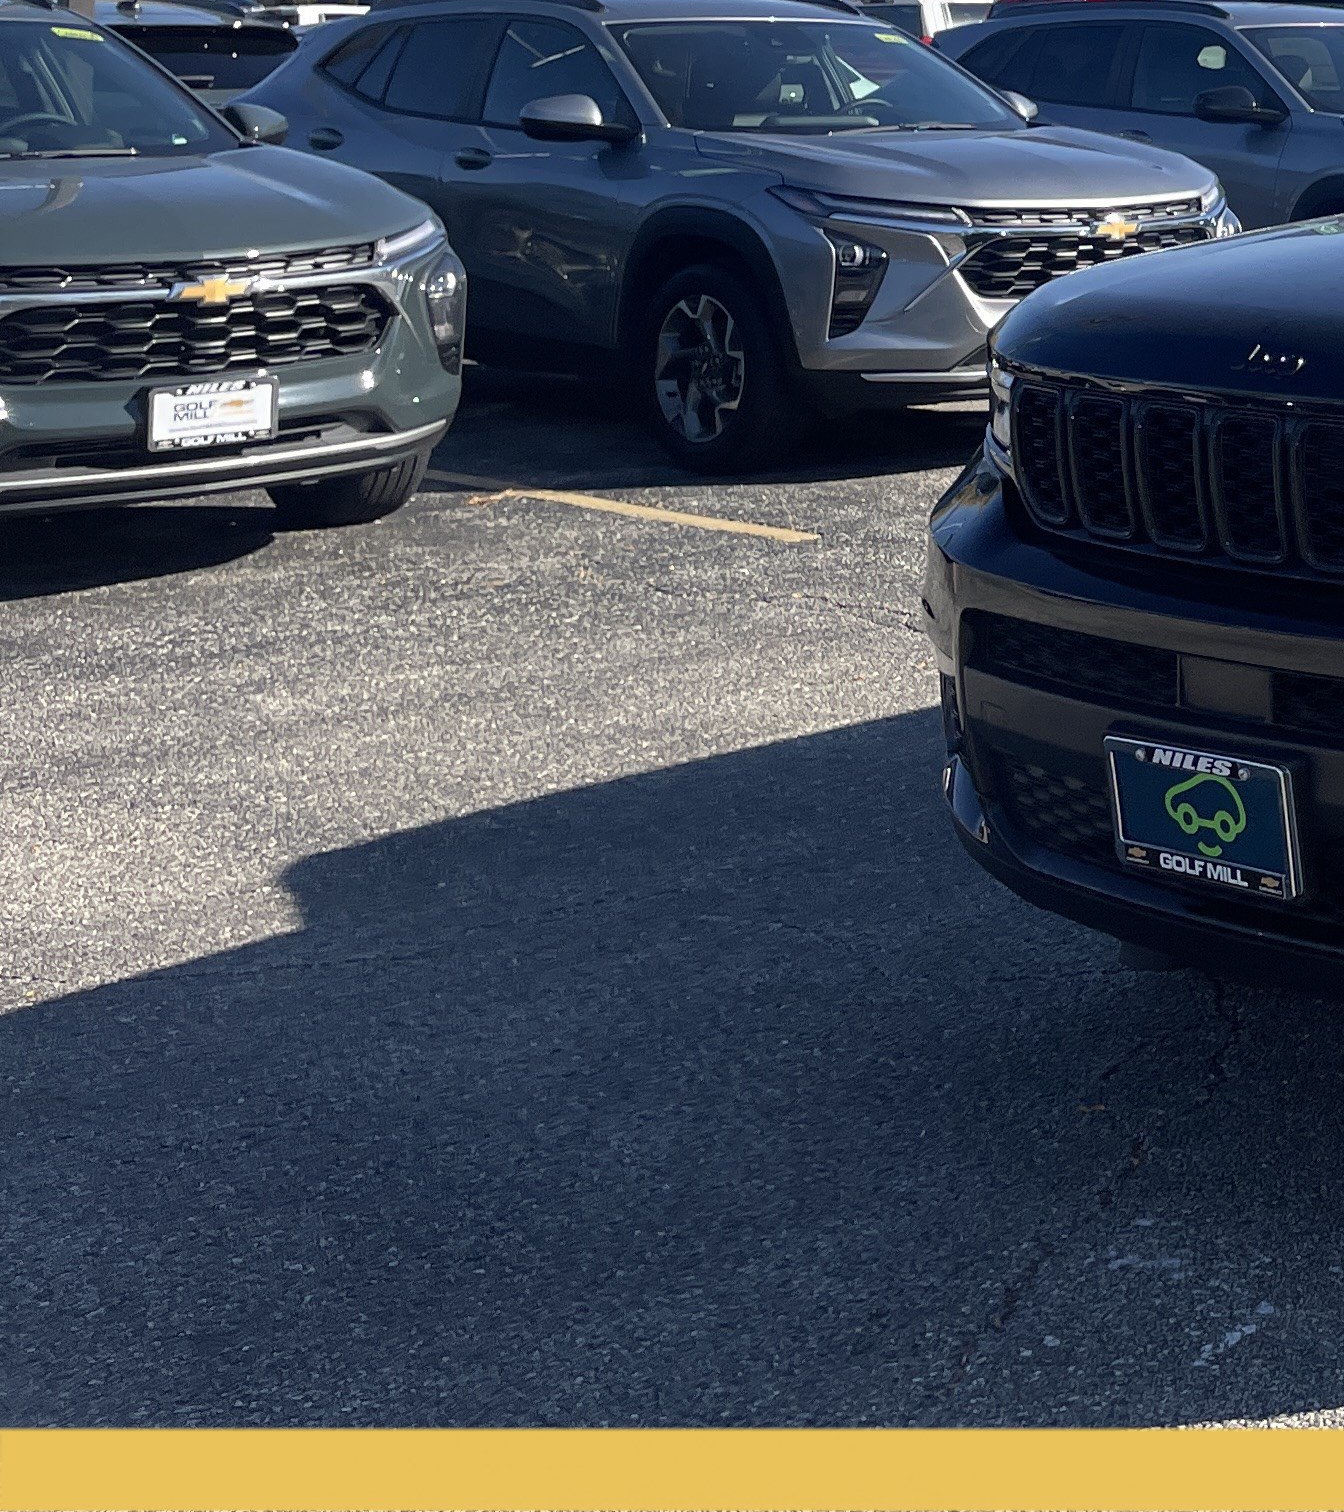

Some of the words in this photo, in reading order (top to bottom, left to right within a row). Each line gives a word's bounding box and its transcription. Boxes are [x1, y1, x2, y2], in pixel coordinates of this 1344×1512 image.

[173, 400, 216, 413] GOLF
[173, 408, 208, 422] MILL
[1152, 748, 1233, 777] NILES
[1159, 852, 1205, 876] GOLF
[1206, 864, 1249, 888] MILL
